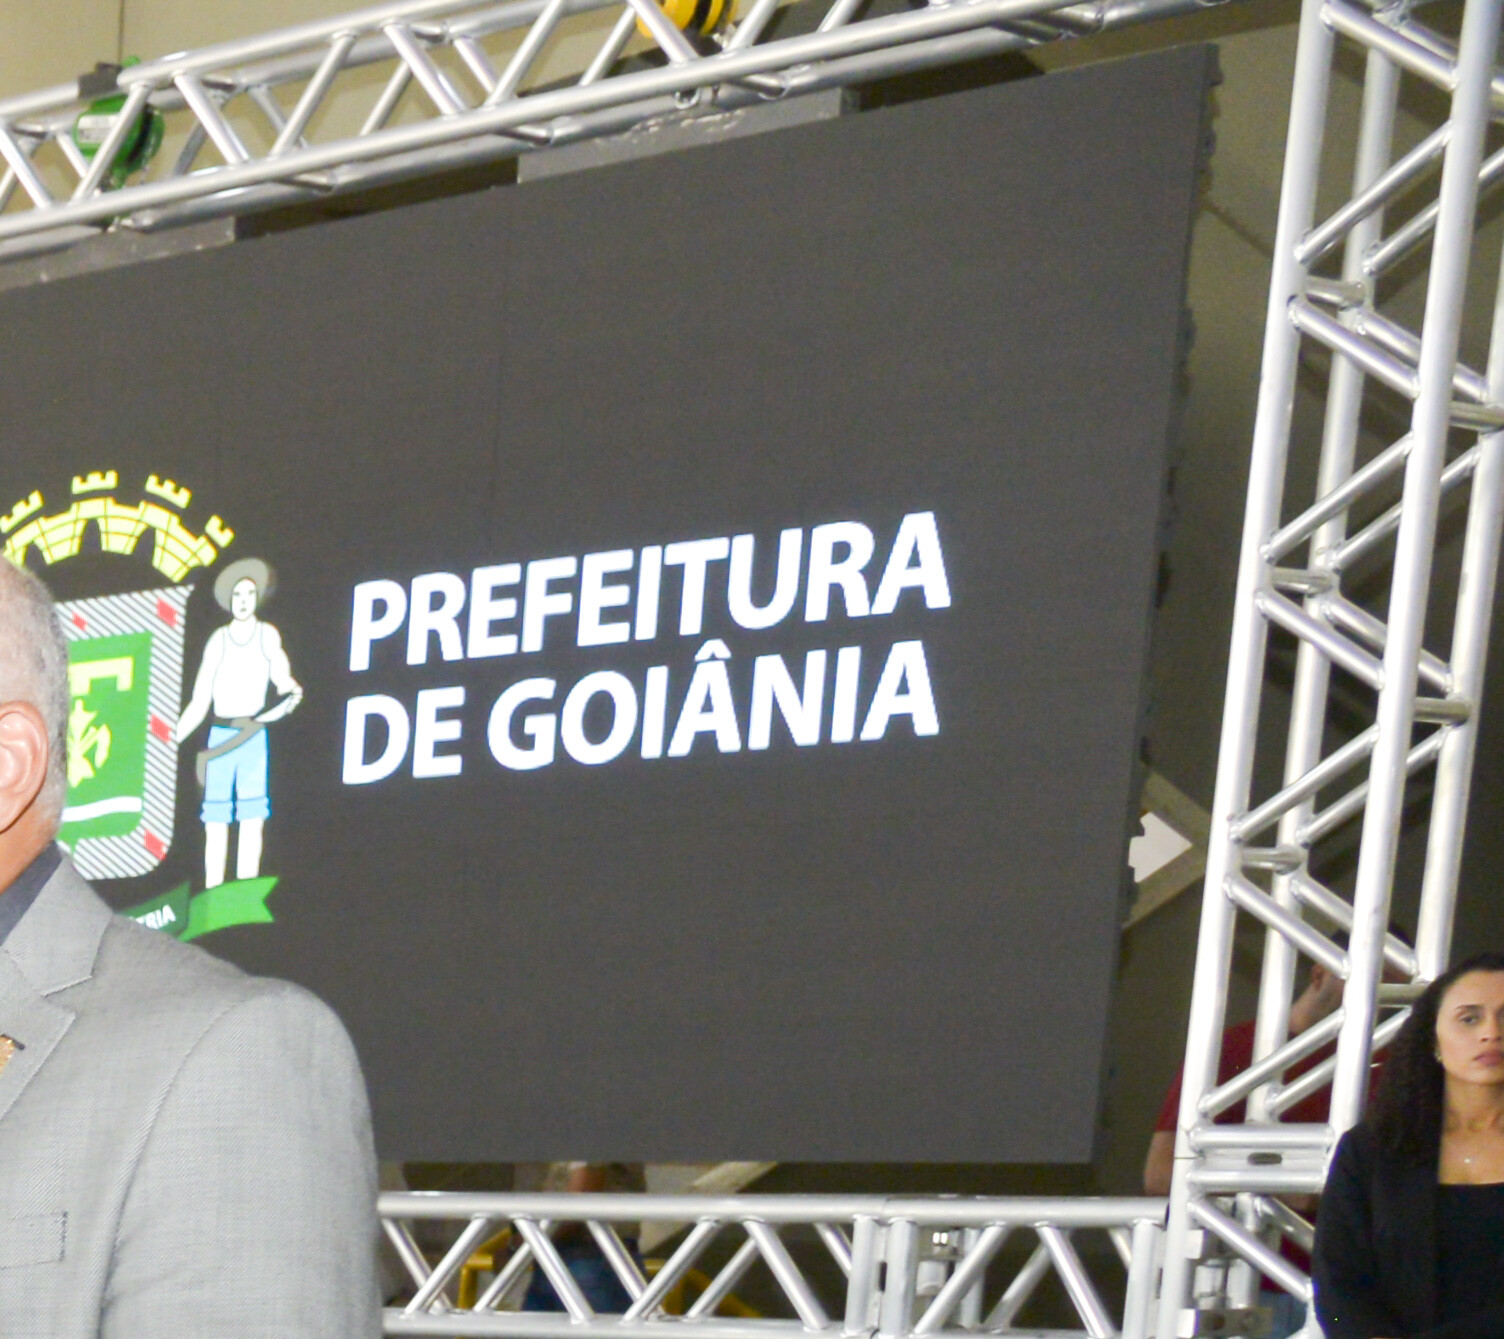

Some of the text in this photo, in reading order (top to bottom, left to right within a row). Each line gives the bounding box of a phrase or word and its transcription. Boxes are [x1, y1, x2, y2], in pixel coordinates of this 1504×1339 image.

[349, 511, 952, 672] PREFEITURA
[342, 639, 940, 785] DE GOIÂNIA
